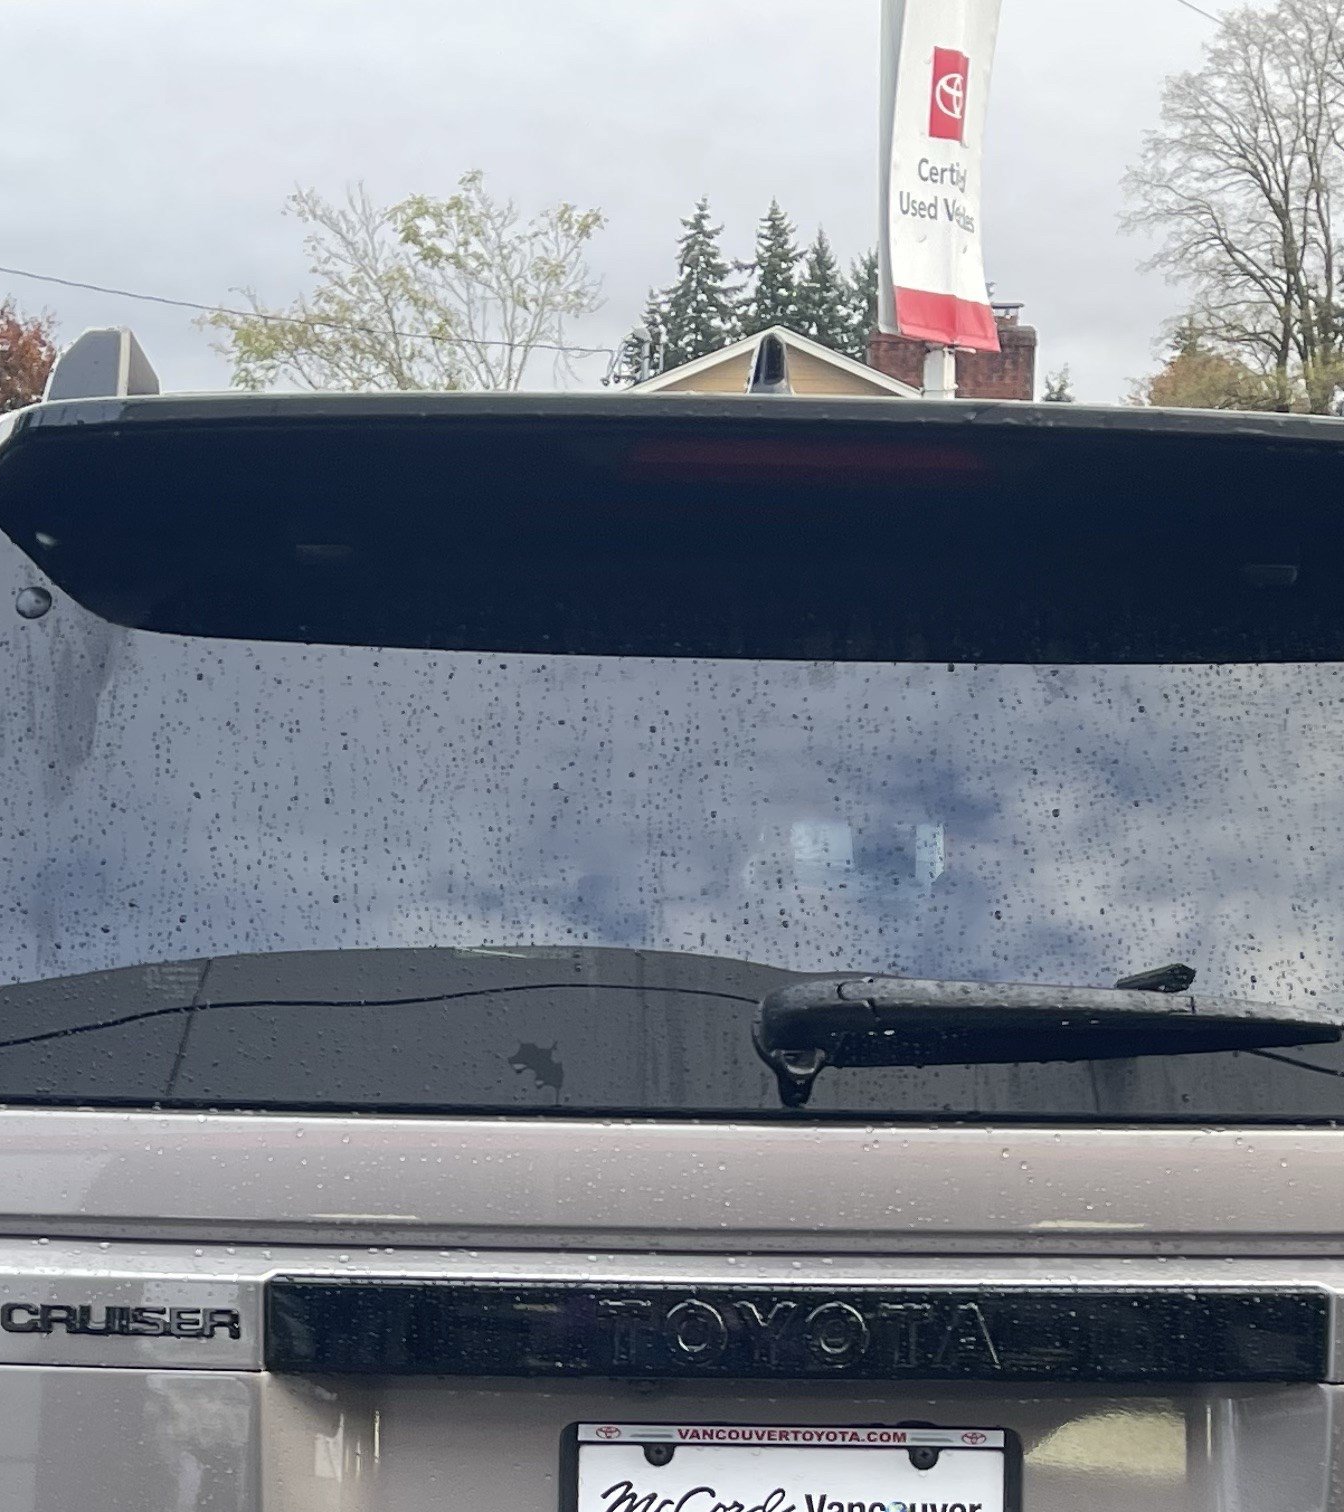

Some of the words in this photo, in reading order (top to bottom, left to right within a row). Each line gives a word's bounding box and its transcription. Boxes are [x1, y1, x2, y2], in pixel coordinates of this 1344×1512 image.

[899, 191, 938, 220] Used
[0, 1302, 241, 1340] CRUISER
[599, 1299, 1002, 1369] TOYOTA
[676, 1428, 908, 1444] VANCOUVERTOYOTA.COM
